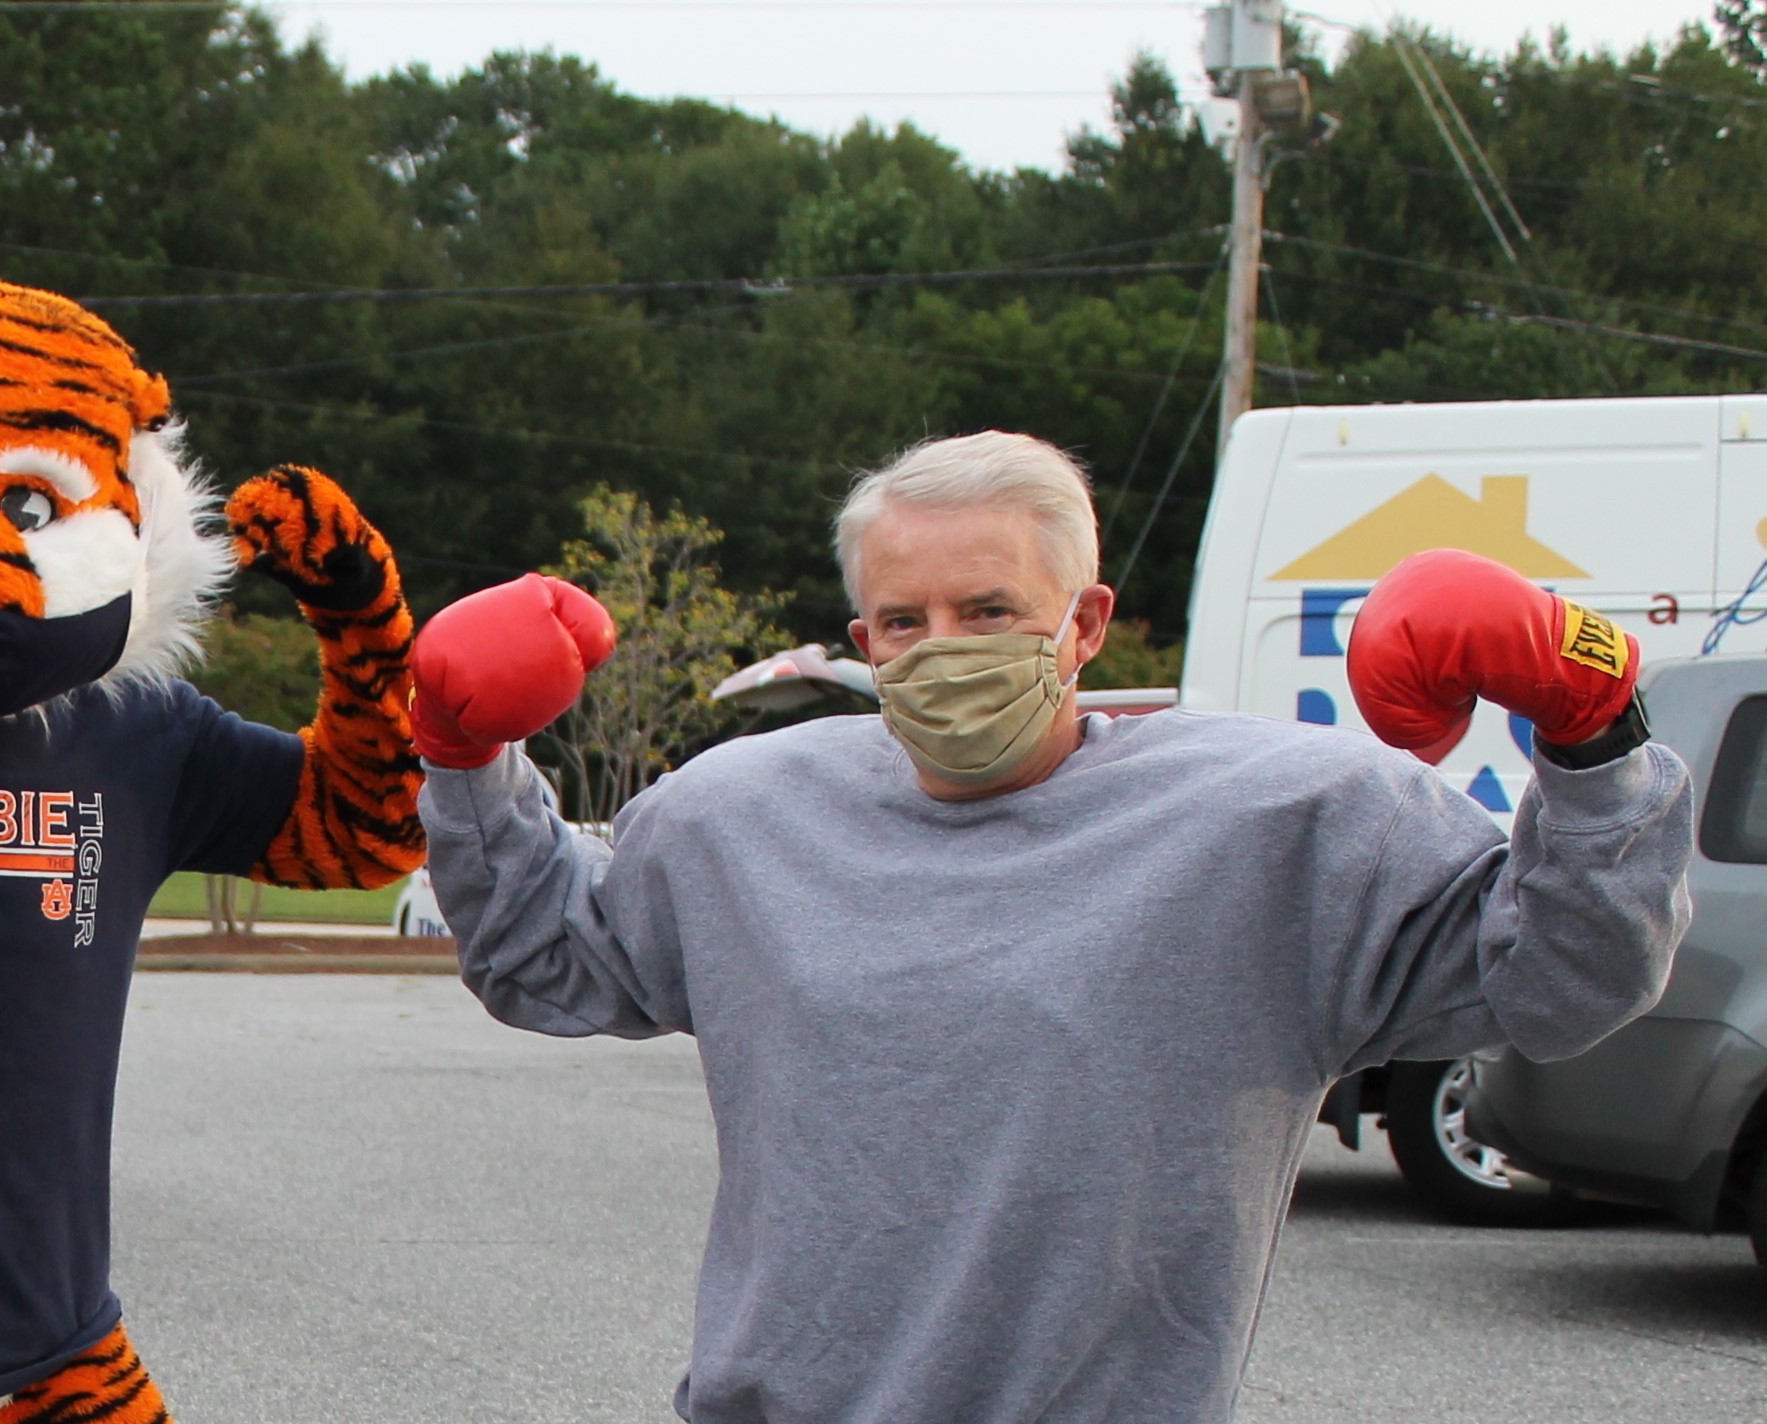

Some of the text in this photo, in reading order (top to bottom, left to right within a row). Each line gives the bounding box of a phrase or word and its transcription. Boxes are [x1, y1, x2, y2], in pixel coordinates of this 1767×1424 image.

[1647, 593, 1678, 625] a
[47, 857, 69, 869] THE
[74, 792, 104, 948] TIGER
